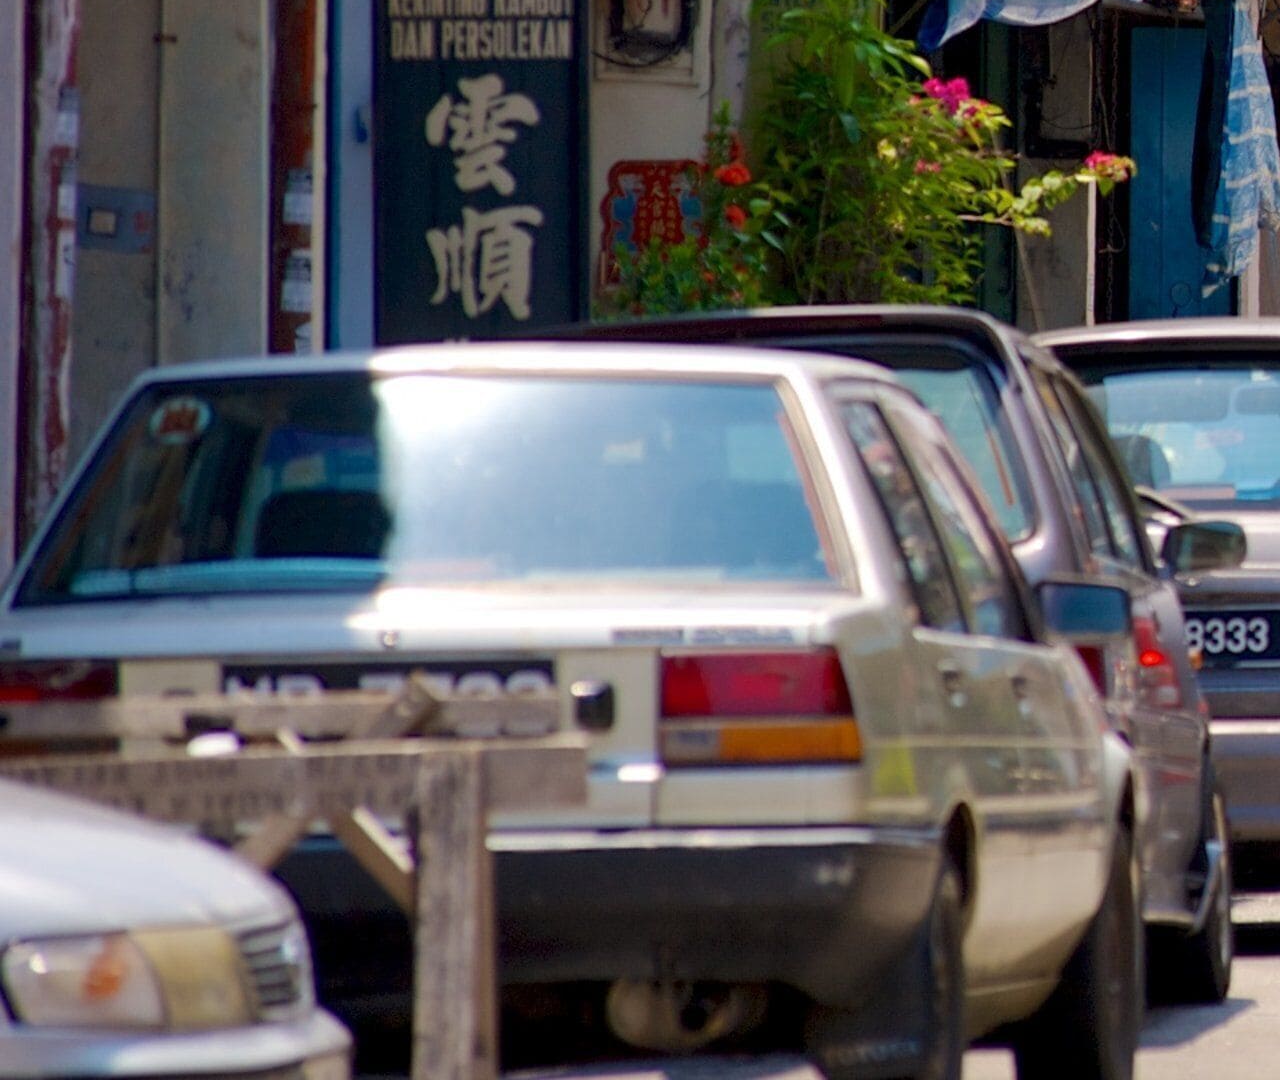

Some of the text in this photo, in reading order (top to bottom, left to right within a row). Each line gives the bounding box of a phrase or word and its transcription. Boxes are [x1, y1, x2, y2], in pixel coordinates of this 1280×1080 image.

[391, 20, 572, 60] DAN PERSOLEKAN
[425, 73, 544, 320] 雲順
[1185, 618, 1270, 654] 8333
